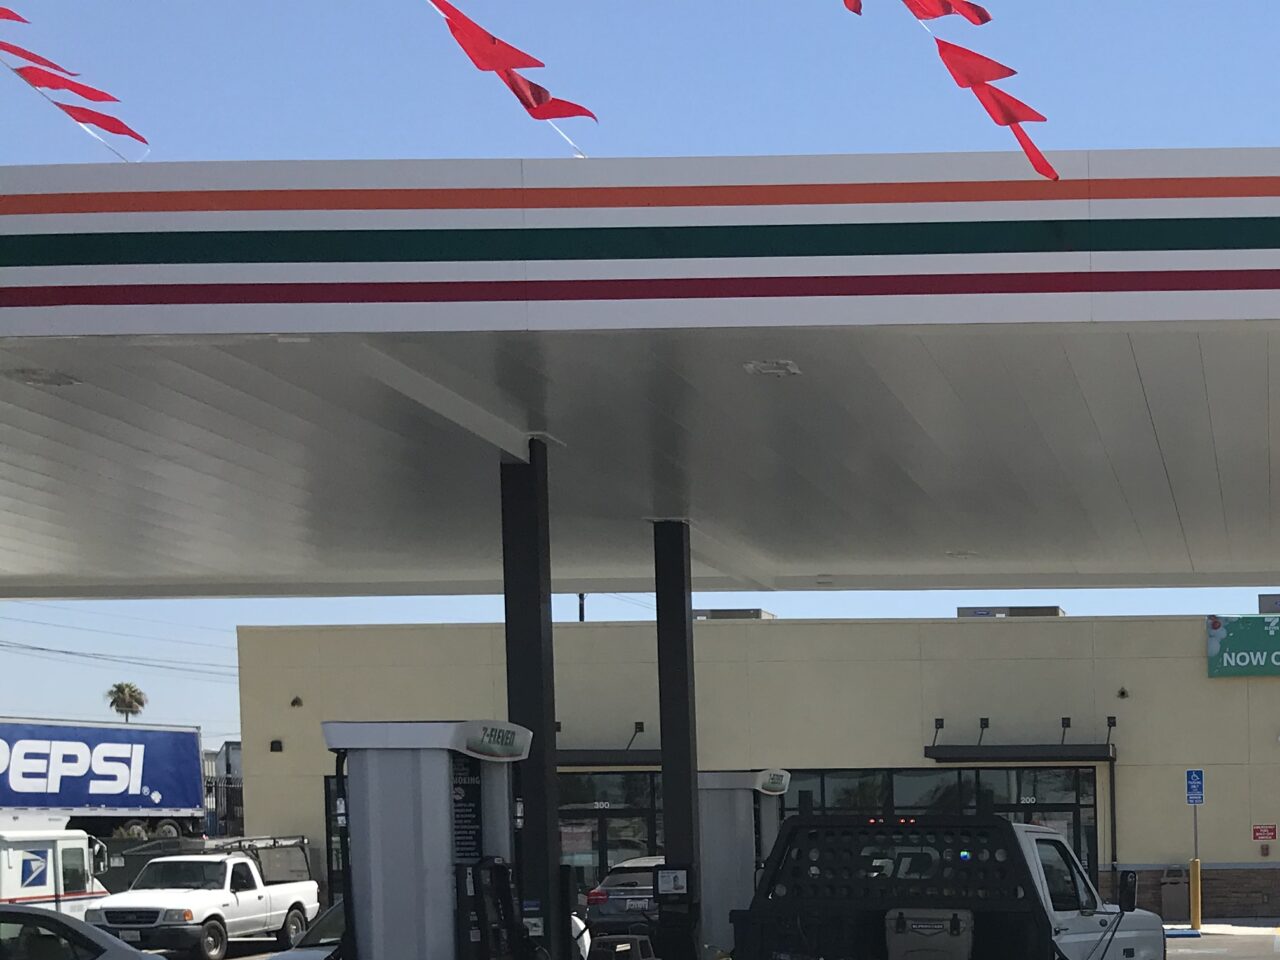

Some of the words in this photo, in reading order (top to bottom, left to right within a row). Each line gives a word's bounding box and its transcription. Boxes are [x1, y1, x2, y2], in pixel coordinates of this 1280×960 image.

[1223, 651, 1268, 667] NOW
[481, 726, 517, 747] 7-ELEVEN
[0, 738, 146, 795] EPSI
[453, 775, 481, 785] MOKING
[593, 801, 610, 809] 300
[1020, 796, 1036, 804] 200
